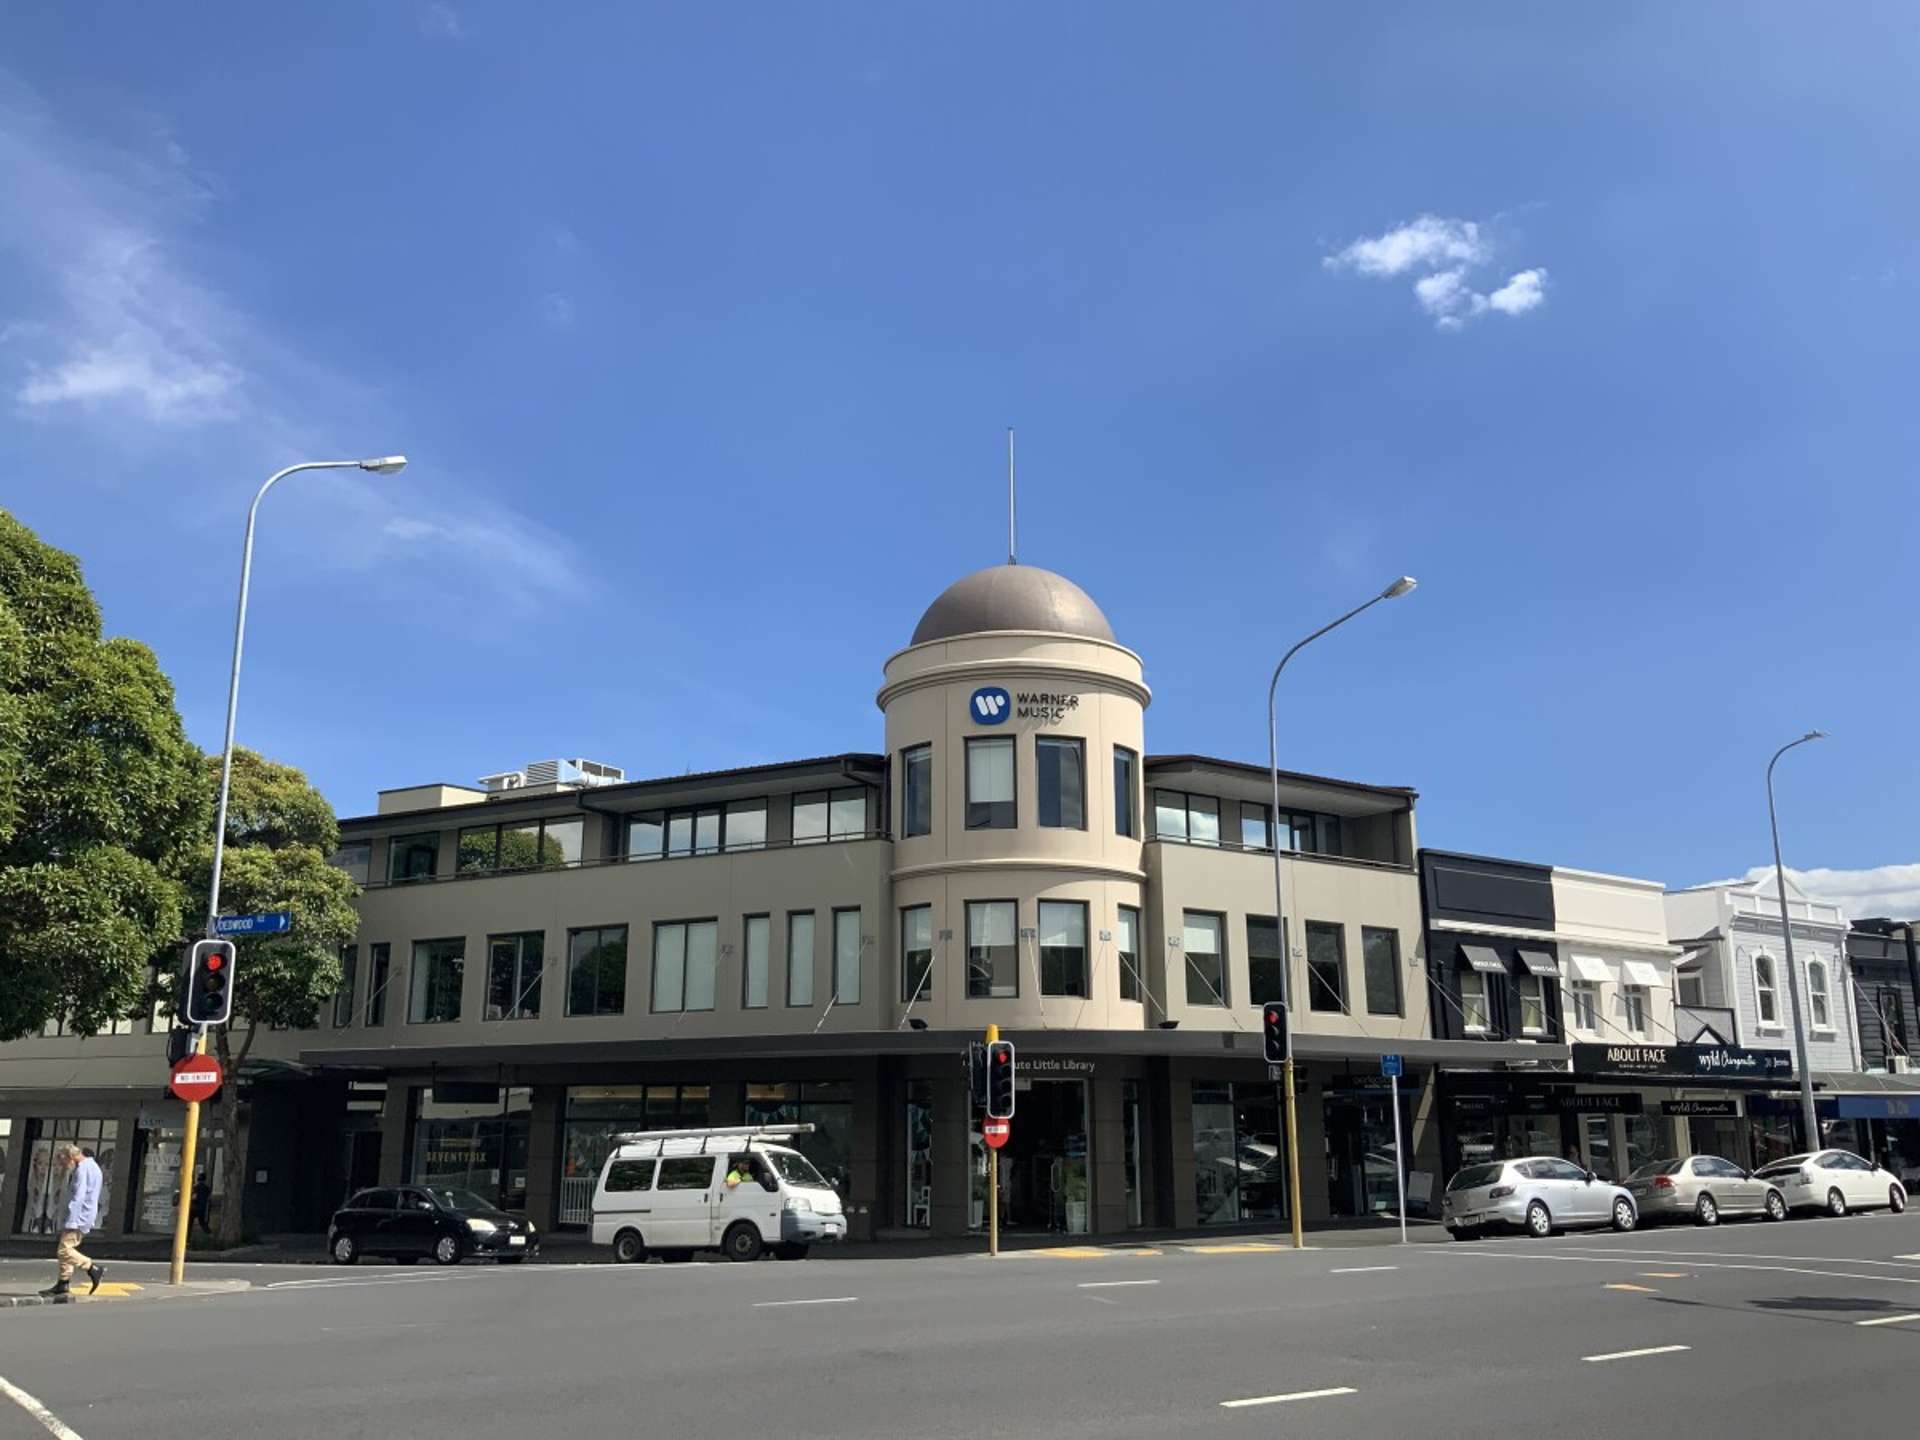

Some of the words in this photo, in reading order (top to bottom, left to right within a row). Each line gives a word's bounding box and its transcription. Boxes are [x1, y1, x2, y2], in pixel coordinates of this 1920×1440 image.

[1017, 693, 1079, 706] WARNER
[1017, 707, 1065, 719] MUSIC
[1607, 1047, 1641, 1062] ABOUT
[1643, 1048, 1667, 1063] FACE
[1033, 1060, 1060, 1070] Little
[1063, 1060, 1095, 1073] Library
[1560, 1096, 1592, 1107] ABOUT
